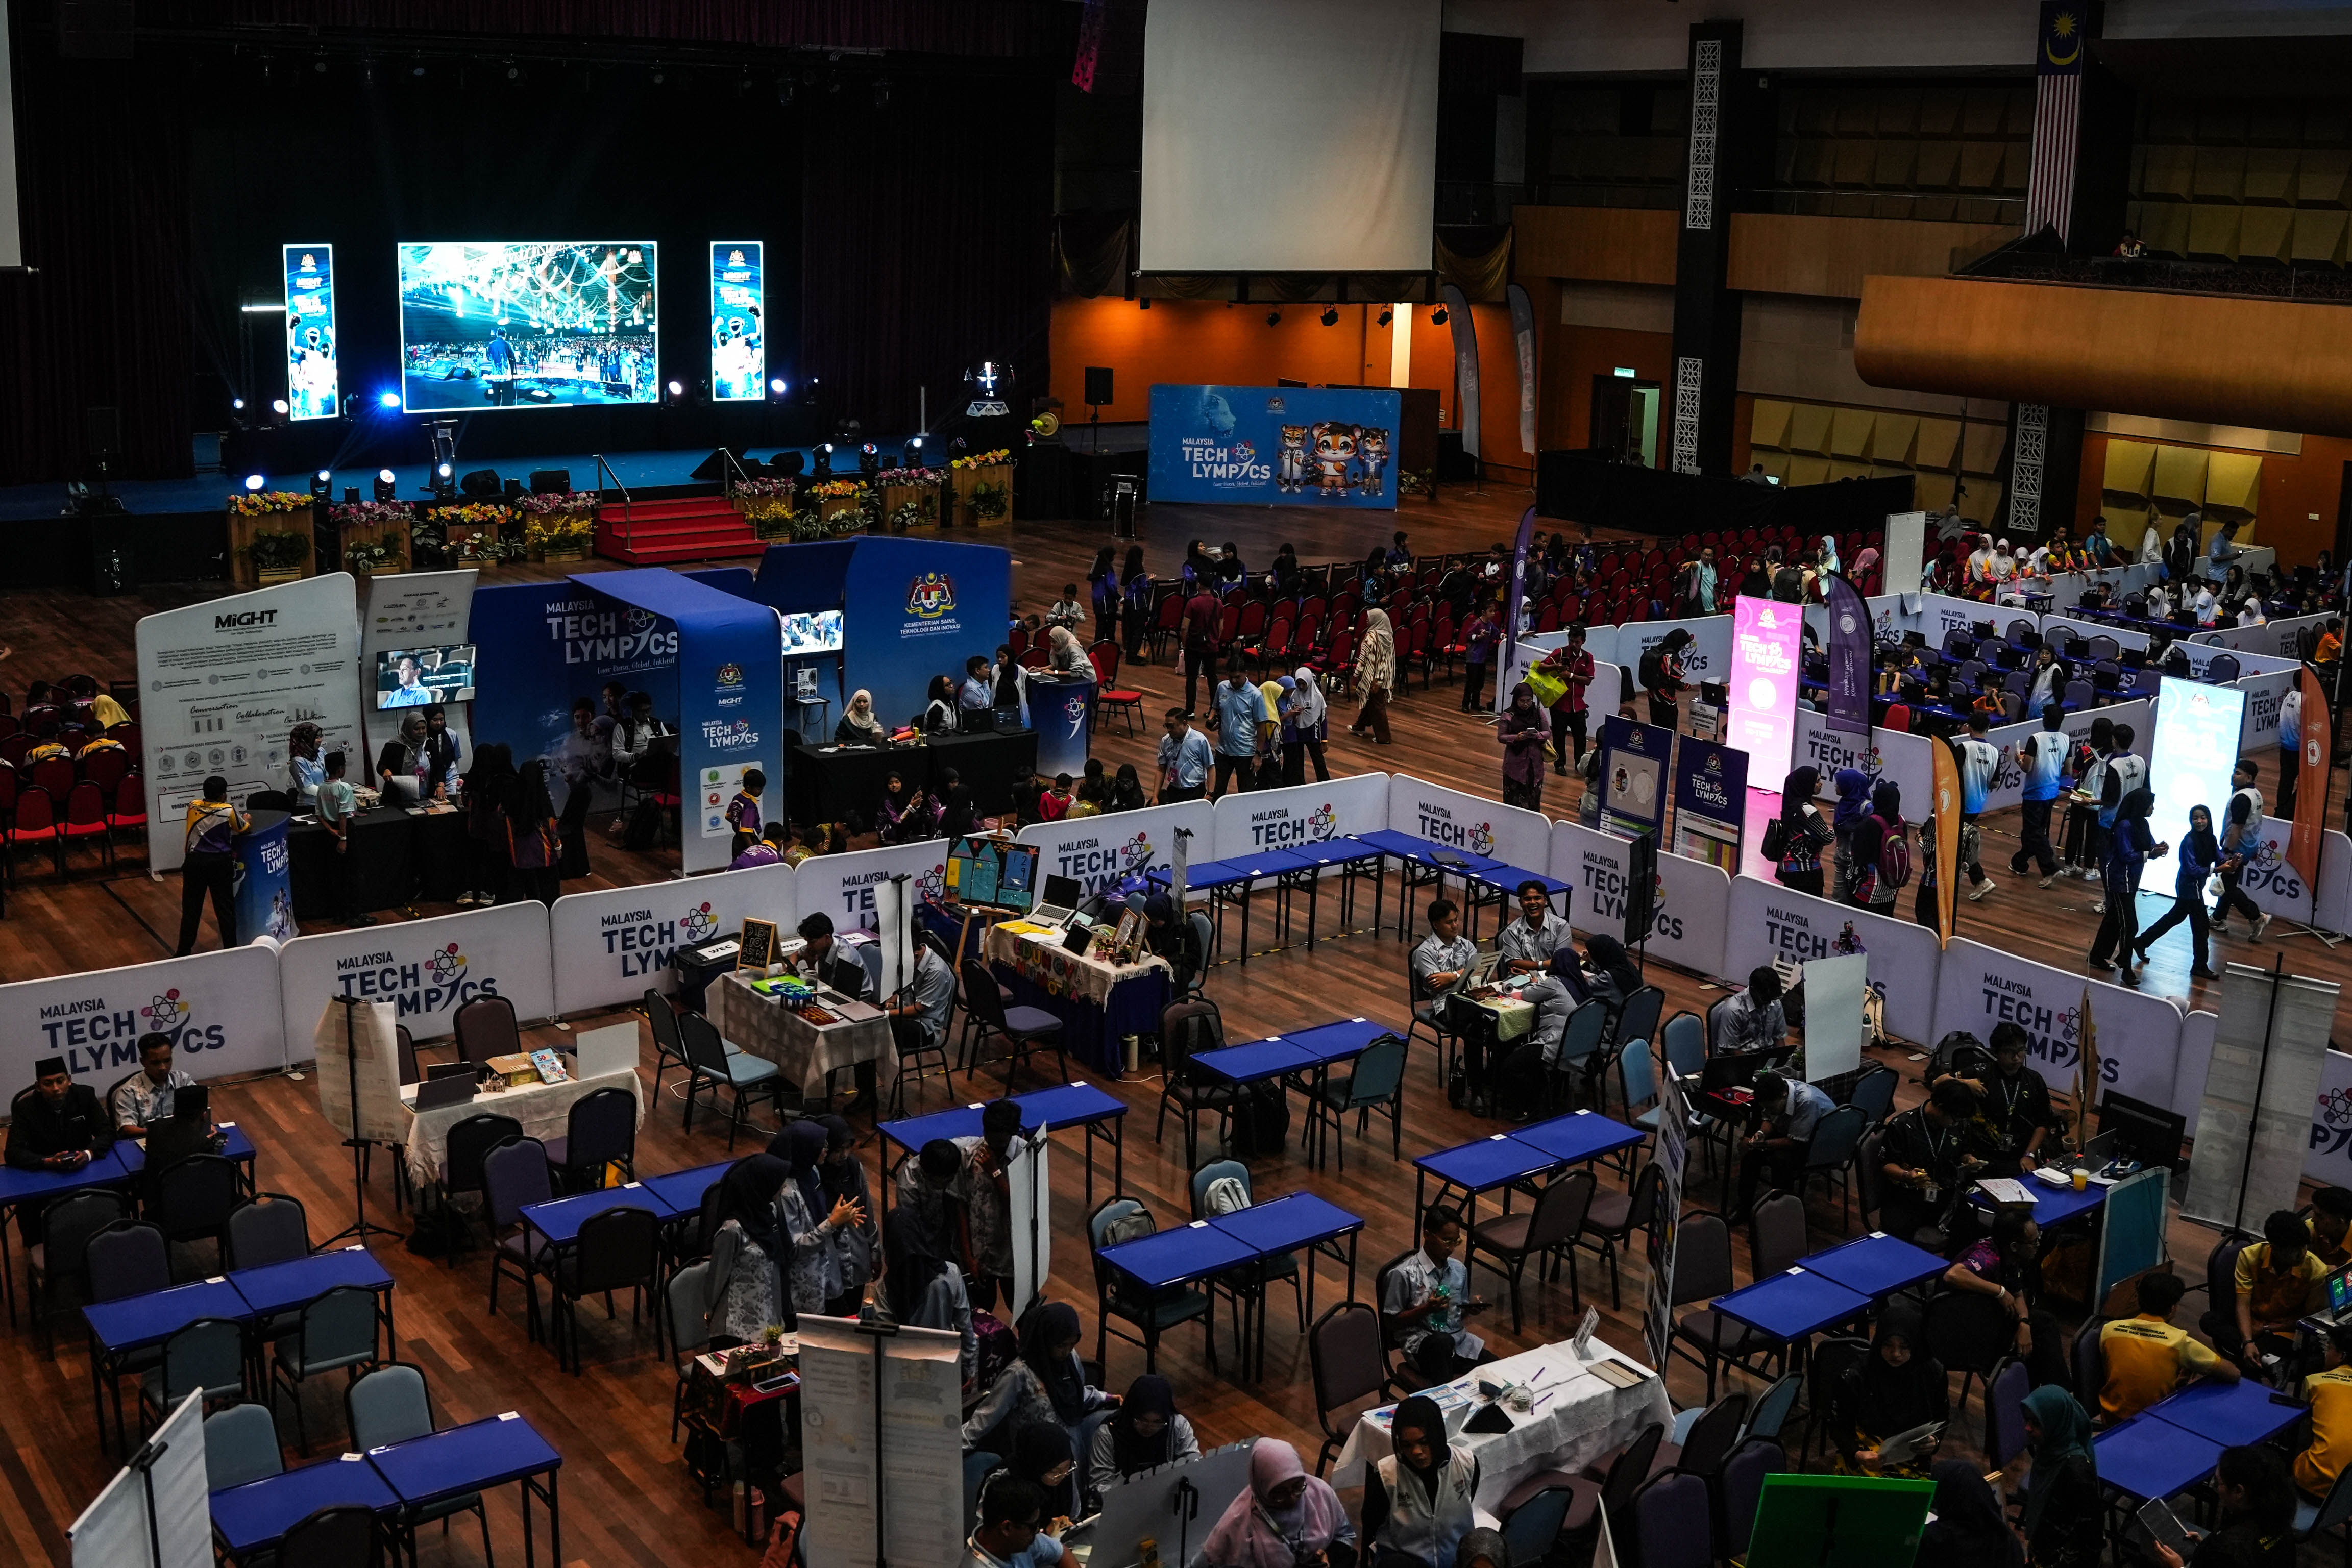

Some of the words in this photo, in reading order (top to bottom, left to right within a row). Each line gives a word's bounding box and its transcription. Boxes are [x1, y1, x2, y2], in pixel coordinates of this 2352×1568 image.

[1182, 447, 1227, 462] TECH
[546, 600, 595, 614] MALAYSIA
[1941, 609, 1966, 619] MALAYSIA
[546, 612, 616, 640] TECH
[900, 627, 929, 635] TEKNOLOGI
[904, 619, 940, 628] KEMENTERIAN
[190, 703, 238, 714] Conversation
[235, 708, 285, 720] Collaboration
[2252, 697, 2276, 716] TECH
[702, 725, 731, 738] TECH
[1809, 729, 1841, 745] MALAYSIA
[1808, 740, 1854, 768] TECH
[1692, 778, 1711, 792] TECH
[1252, 808, 1289, 822] MALAYSIA
[1419, 801, 1451, 820] MALAYSIA
[1252, 819, 1305, 846] TECH
[1419, 815, 1465, 847] TECH
[261, 845, 281, 863] TECH
[1058, 838, 1099, 853] MALAYSIA
[1059, 848, 1117, 877] TECH
[1583, 850, 1619, 871] MALAYSIA
[842, 871, 889, 887] MALAYSIA
[601, 909, 652, 927] MALAYSIA
[1766, 906, 1809, 928] MALAYSIA
[602, 921, 675, 954] TECH
[1766, 921, 1827, 959] TECH
[708, 944, 733, 953] WEC
[337, 951, 394, 970] MALAYSIA
[338, 963, 420, 997] TECH
[1983, 972, 2032, 999] MALAYSIA
[40, 998, 105, 1019] MALAYSIA
[1982, 988, 2052, 1034] TECH
[42, 1010, 136, 1048] TECH
